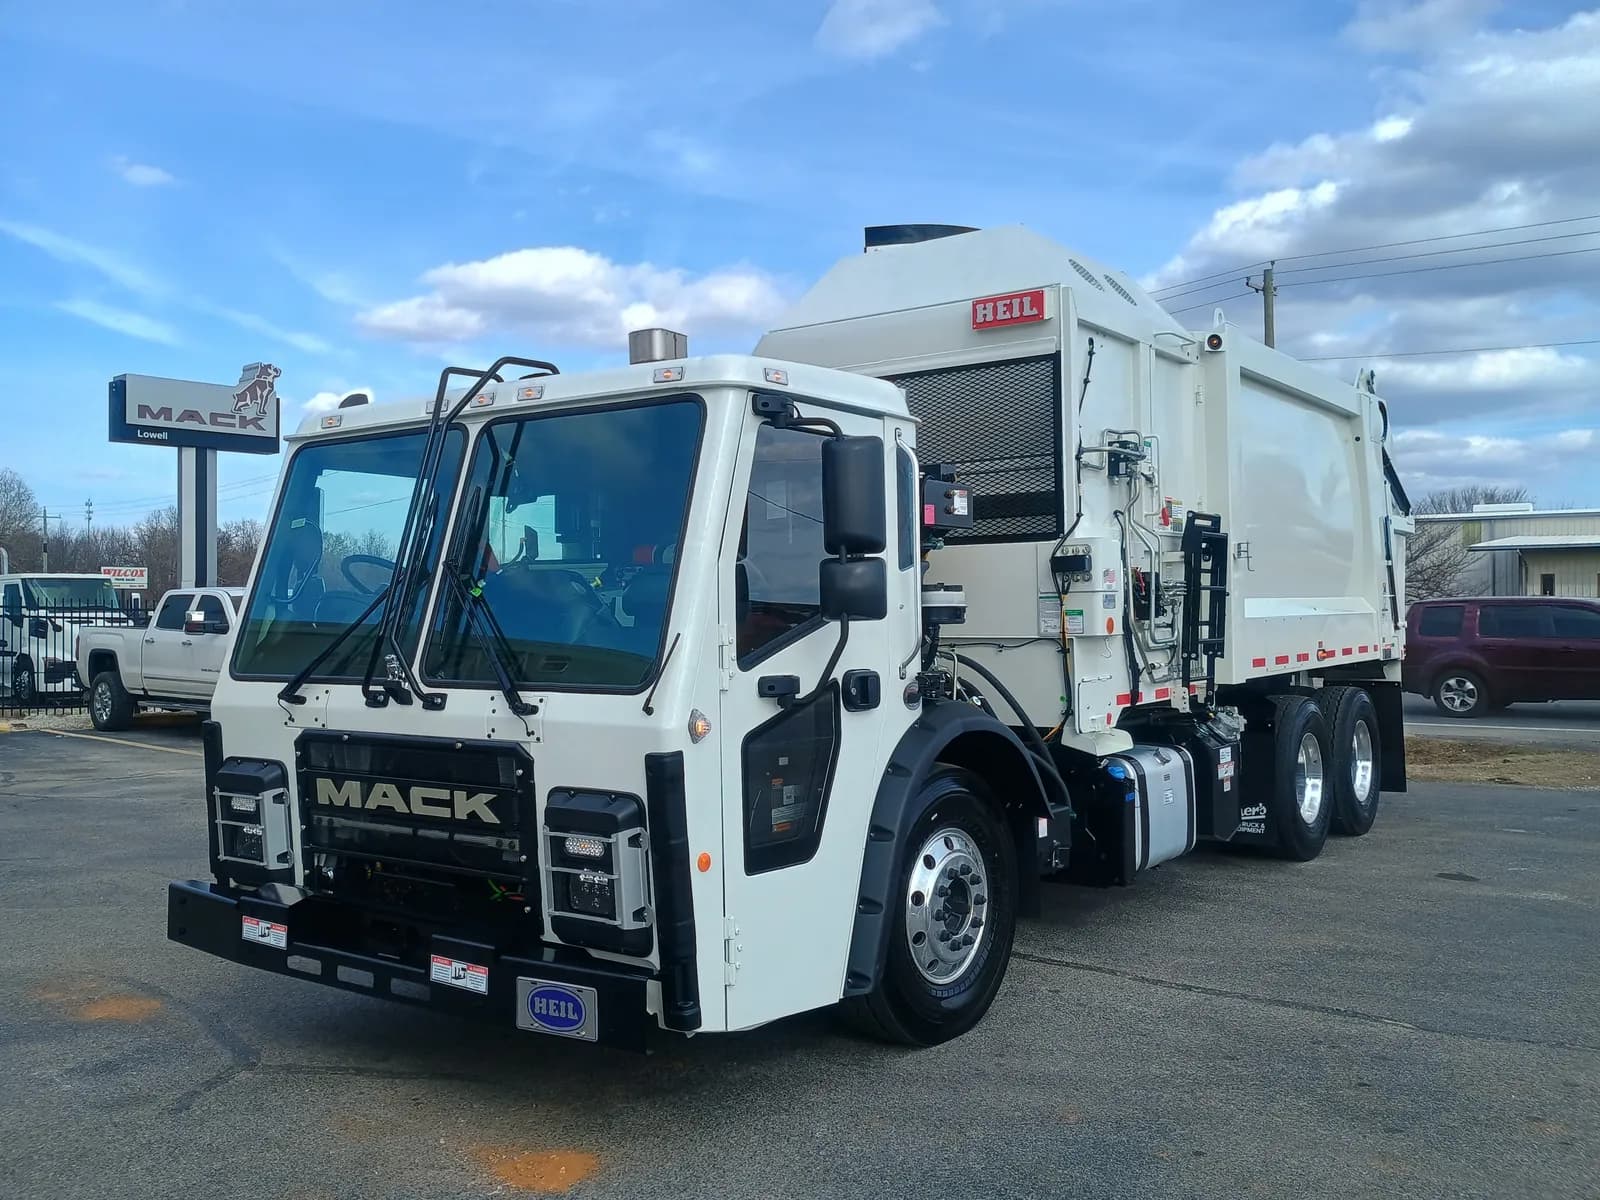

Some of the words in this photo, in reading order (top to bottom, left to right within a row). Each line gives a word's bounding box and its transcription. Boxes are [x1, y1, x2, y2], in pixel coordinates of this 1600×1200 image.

[976, 296, 1038, 323] HEIL
[138, 404, 266, 431] MACK
[137, 430, 168, 440] Lowell
[103, 569, 145, 577] WILCOX
[316, 778, 500, 824] MACK
[534, 997, 578, 1020] HEIL
